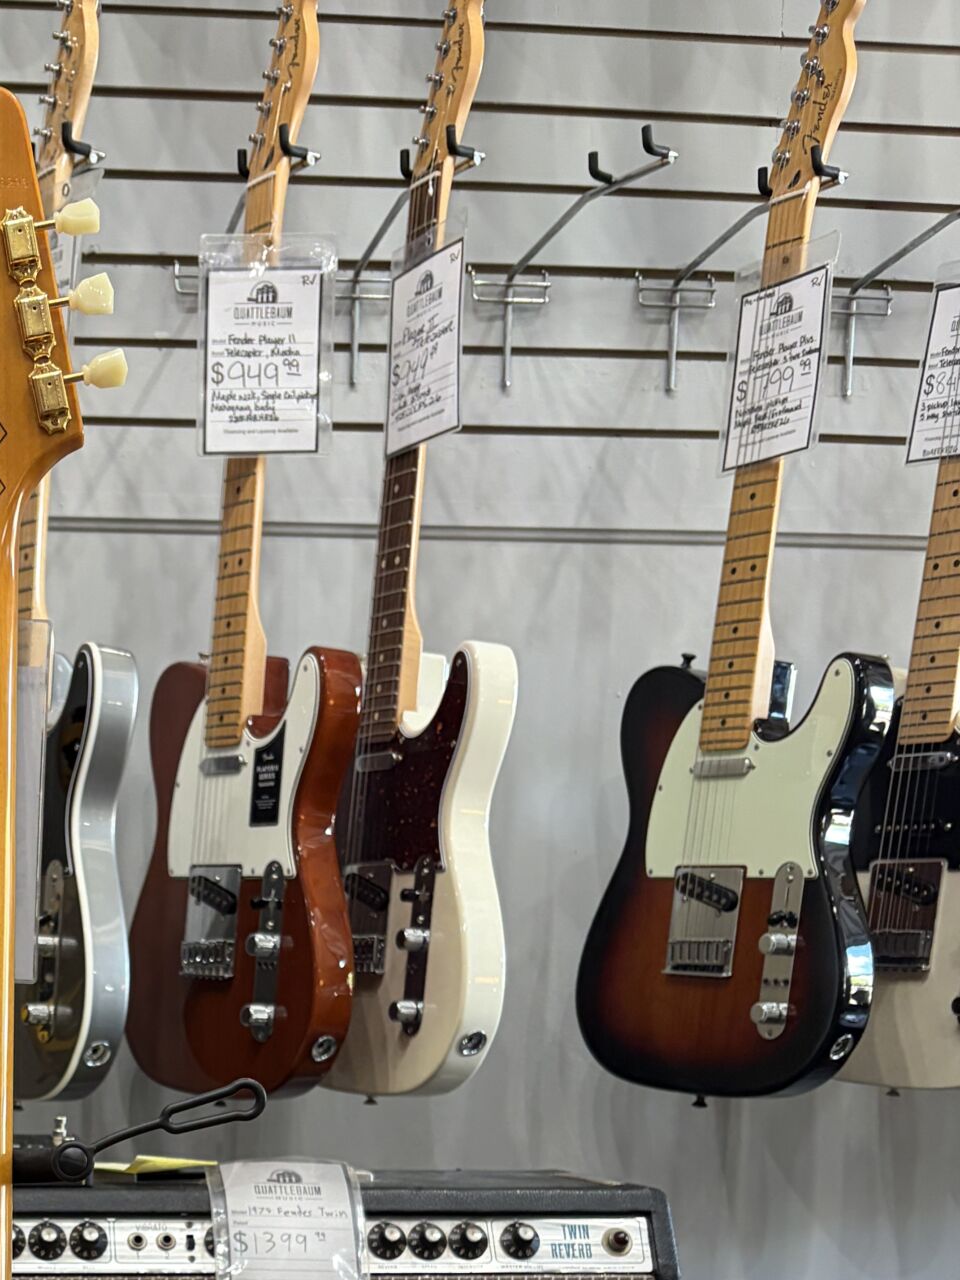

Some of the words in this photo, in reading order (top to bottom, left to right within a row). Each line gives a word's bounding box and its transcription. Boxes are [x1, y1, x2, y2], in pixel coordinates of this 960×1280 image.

[802, 82, 834, 155] Fender
[233, 305, 292, 321] QUATTLEBAUM
[759, 310, 803, 336] QUATTLEBAUM
[228, 333, 255, 345] Fender
[258, 334, 285, 347] Player
[211, 360, 279, 386] $949
[282, 358, 300, 372] 99
[737, 363, 795, 402] $799
[254, 1184, 322, 1196] QUATTLEBAUM
[277, 1205, 312, 1218] Fender
[318, 1206, 348, 1219] Twin
[562, 1224, 590, 1240] TWIN
[233, 1230, 307, 1256] $1399
[551, 1243, 593, 1259] REVERB
